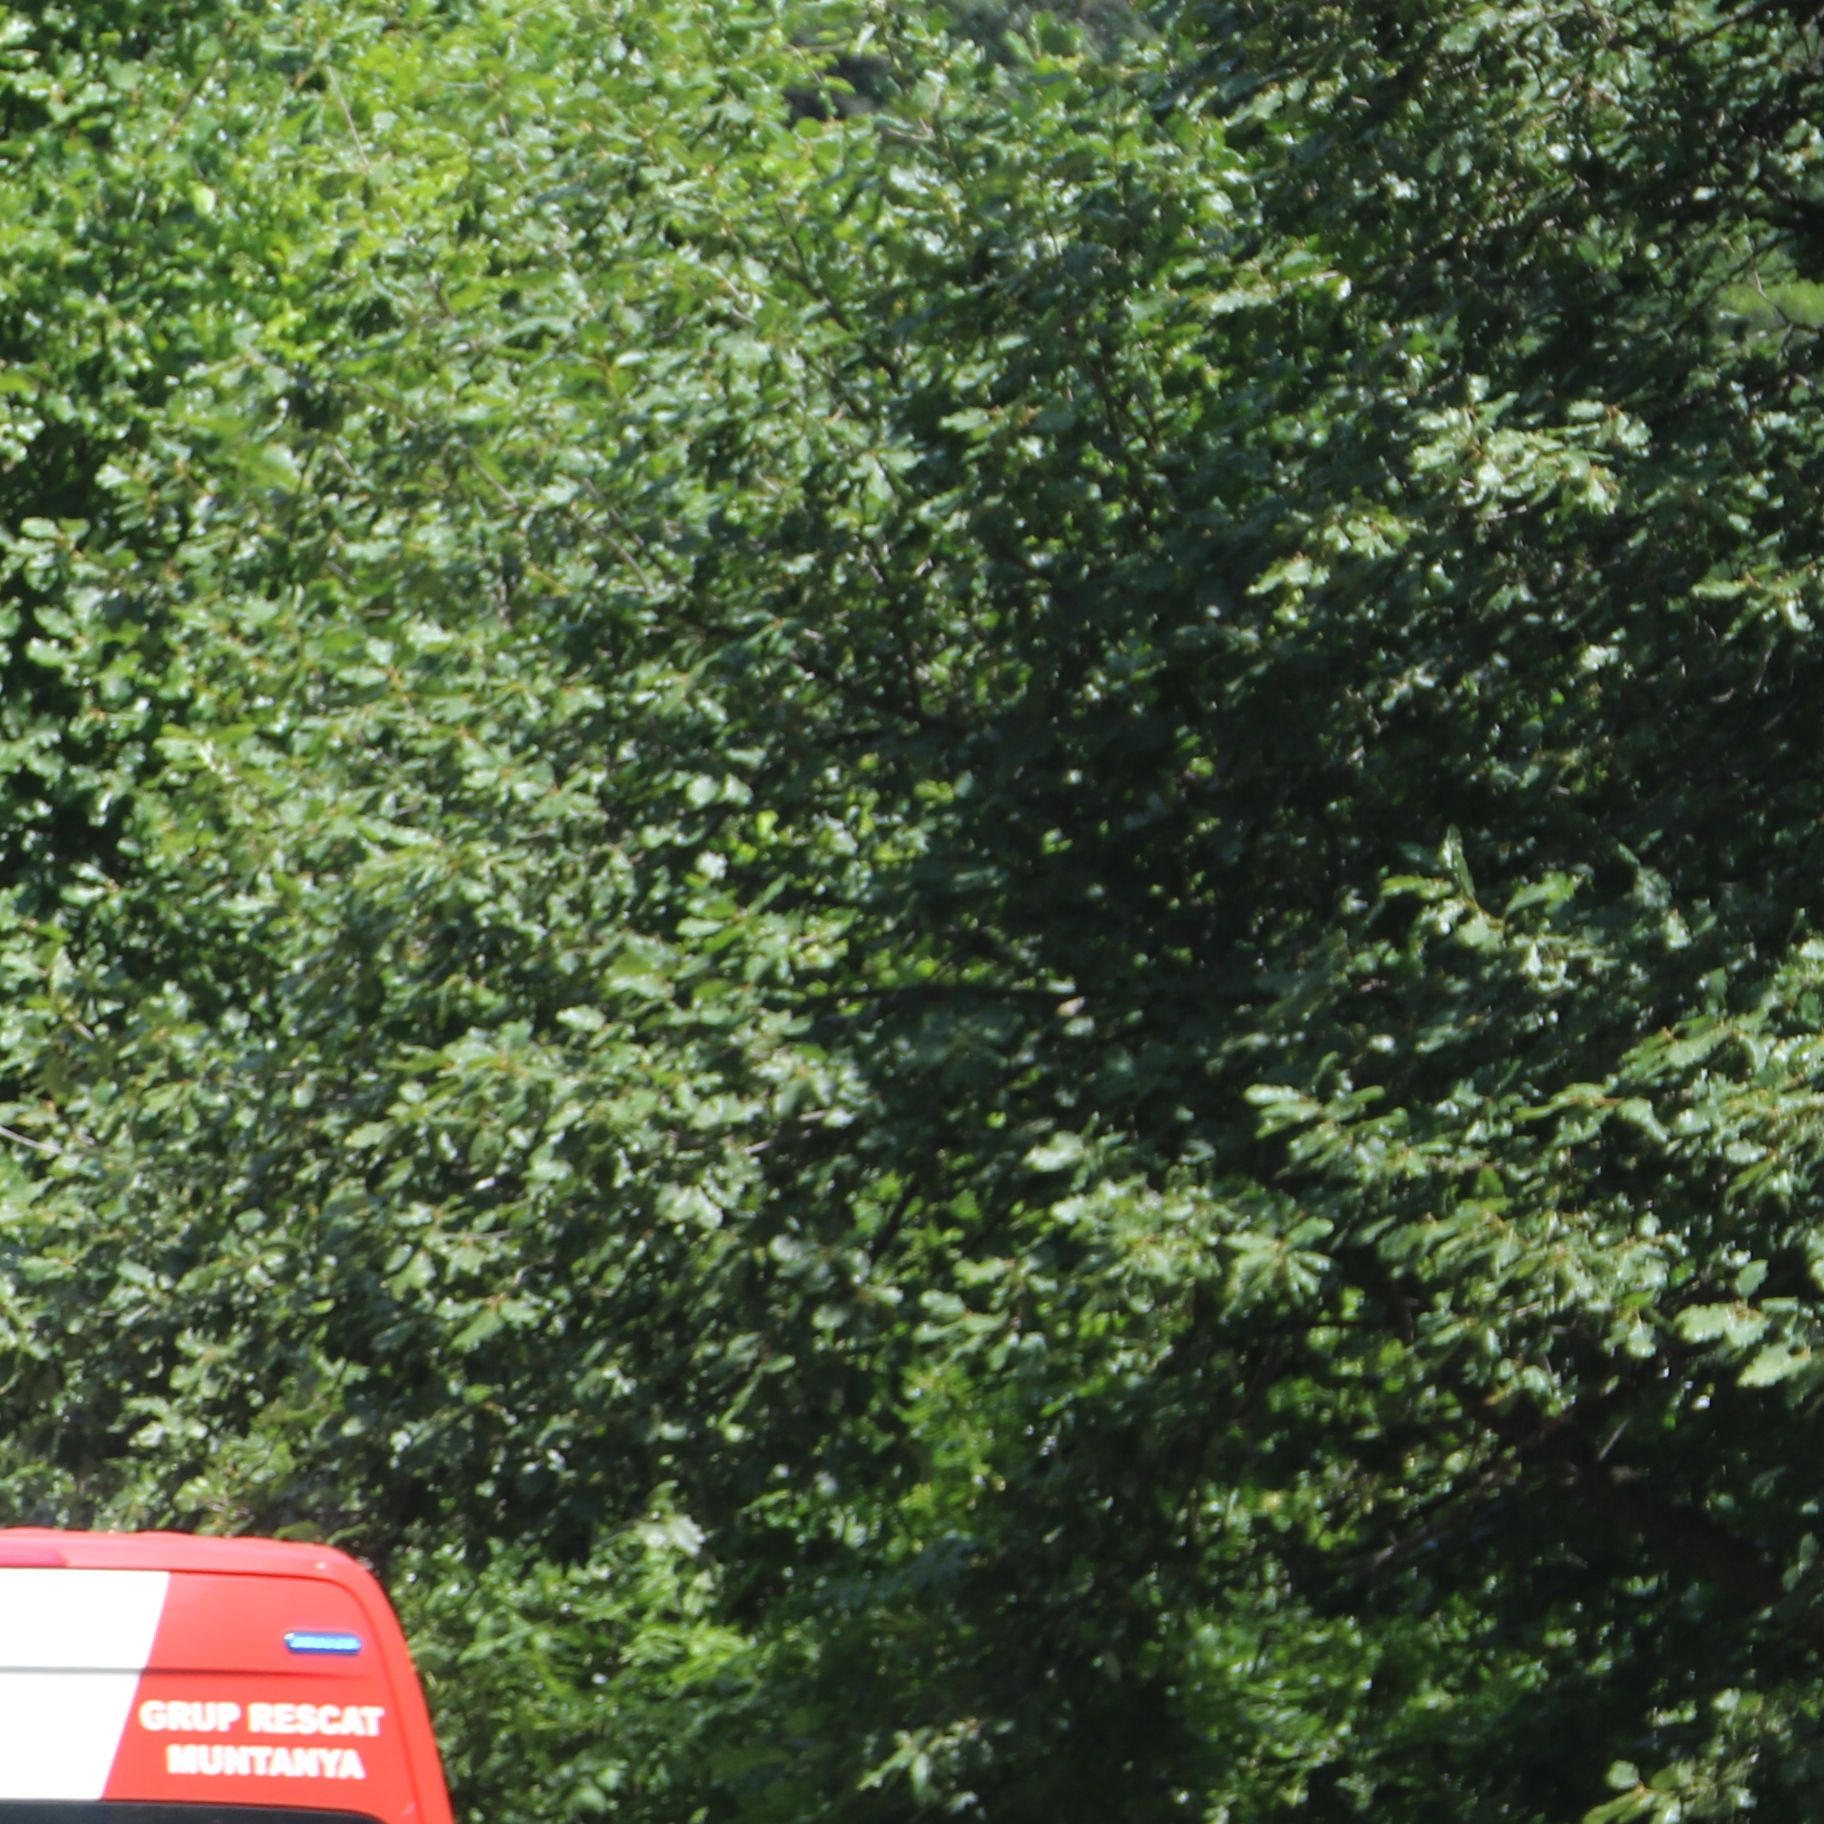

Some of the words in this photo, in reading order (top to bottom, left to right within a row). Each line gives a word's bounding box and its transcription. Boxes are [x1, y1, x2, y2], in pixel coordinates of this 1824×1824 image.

[139, 1700, 241, 1732] GRUP
[248, 1702, 385, 1737] RESCAT
[166, 1744, 366, 1780] MUNTANYA
